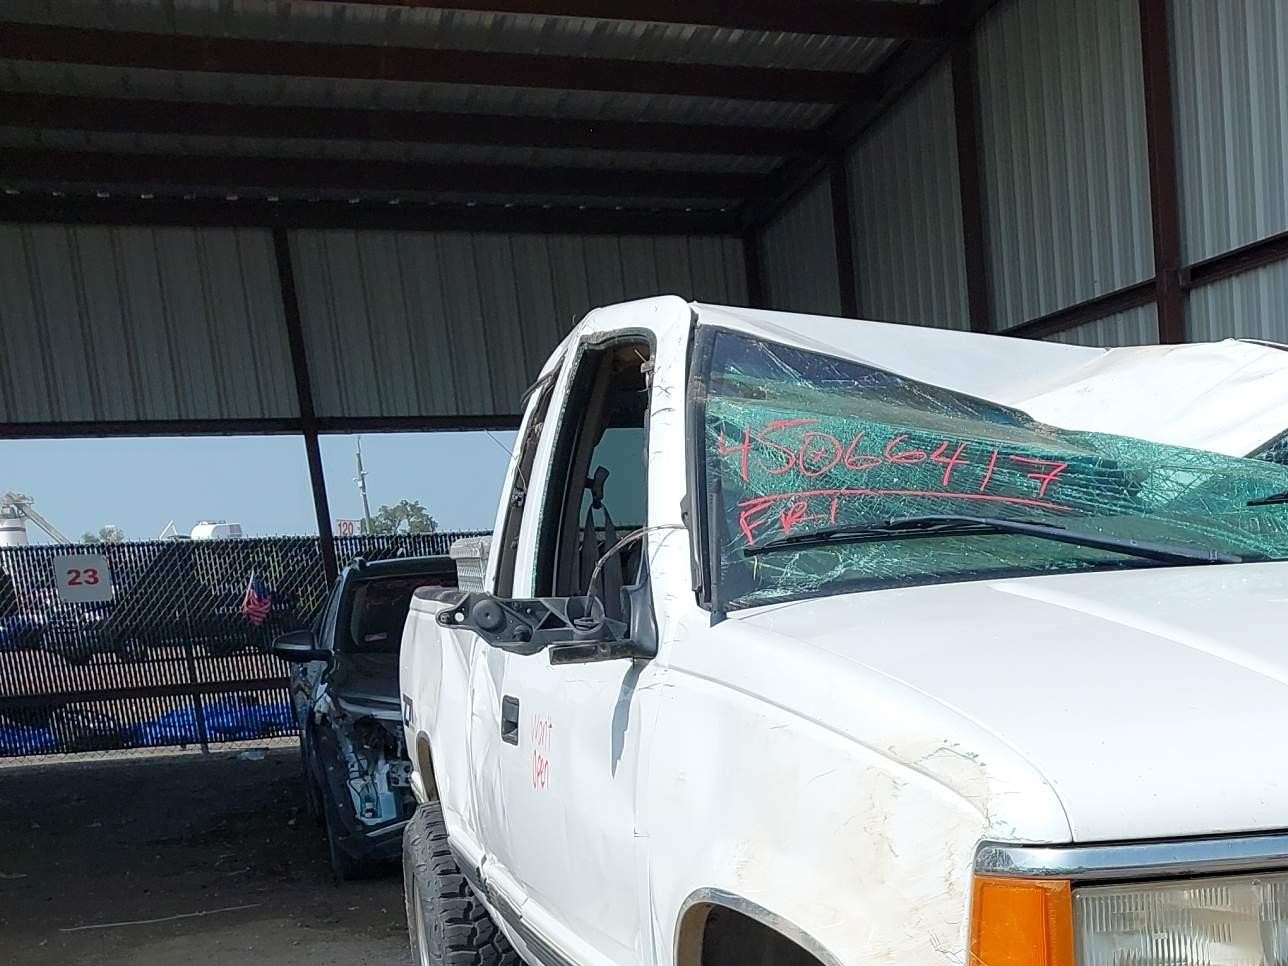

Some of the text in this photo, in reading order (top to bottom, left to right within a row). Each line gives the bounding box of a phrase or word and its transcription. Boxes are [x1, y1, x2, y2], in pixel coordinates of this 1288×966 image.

[720, 419, 1068, 497] 45066417
[338, 521, 354, 536] 120
[66, 568, 100, 586] 23
